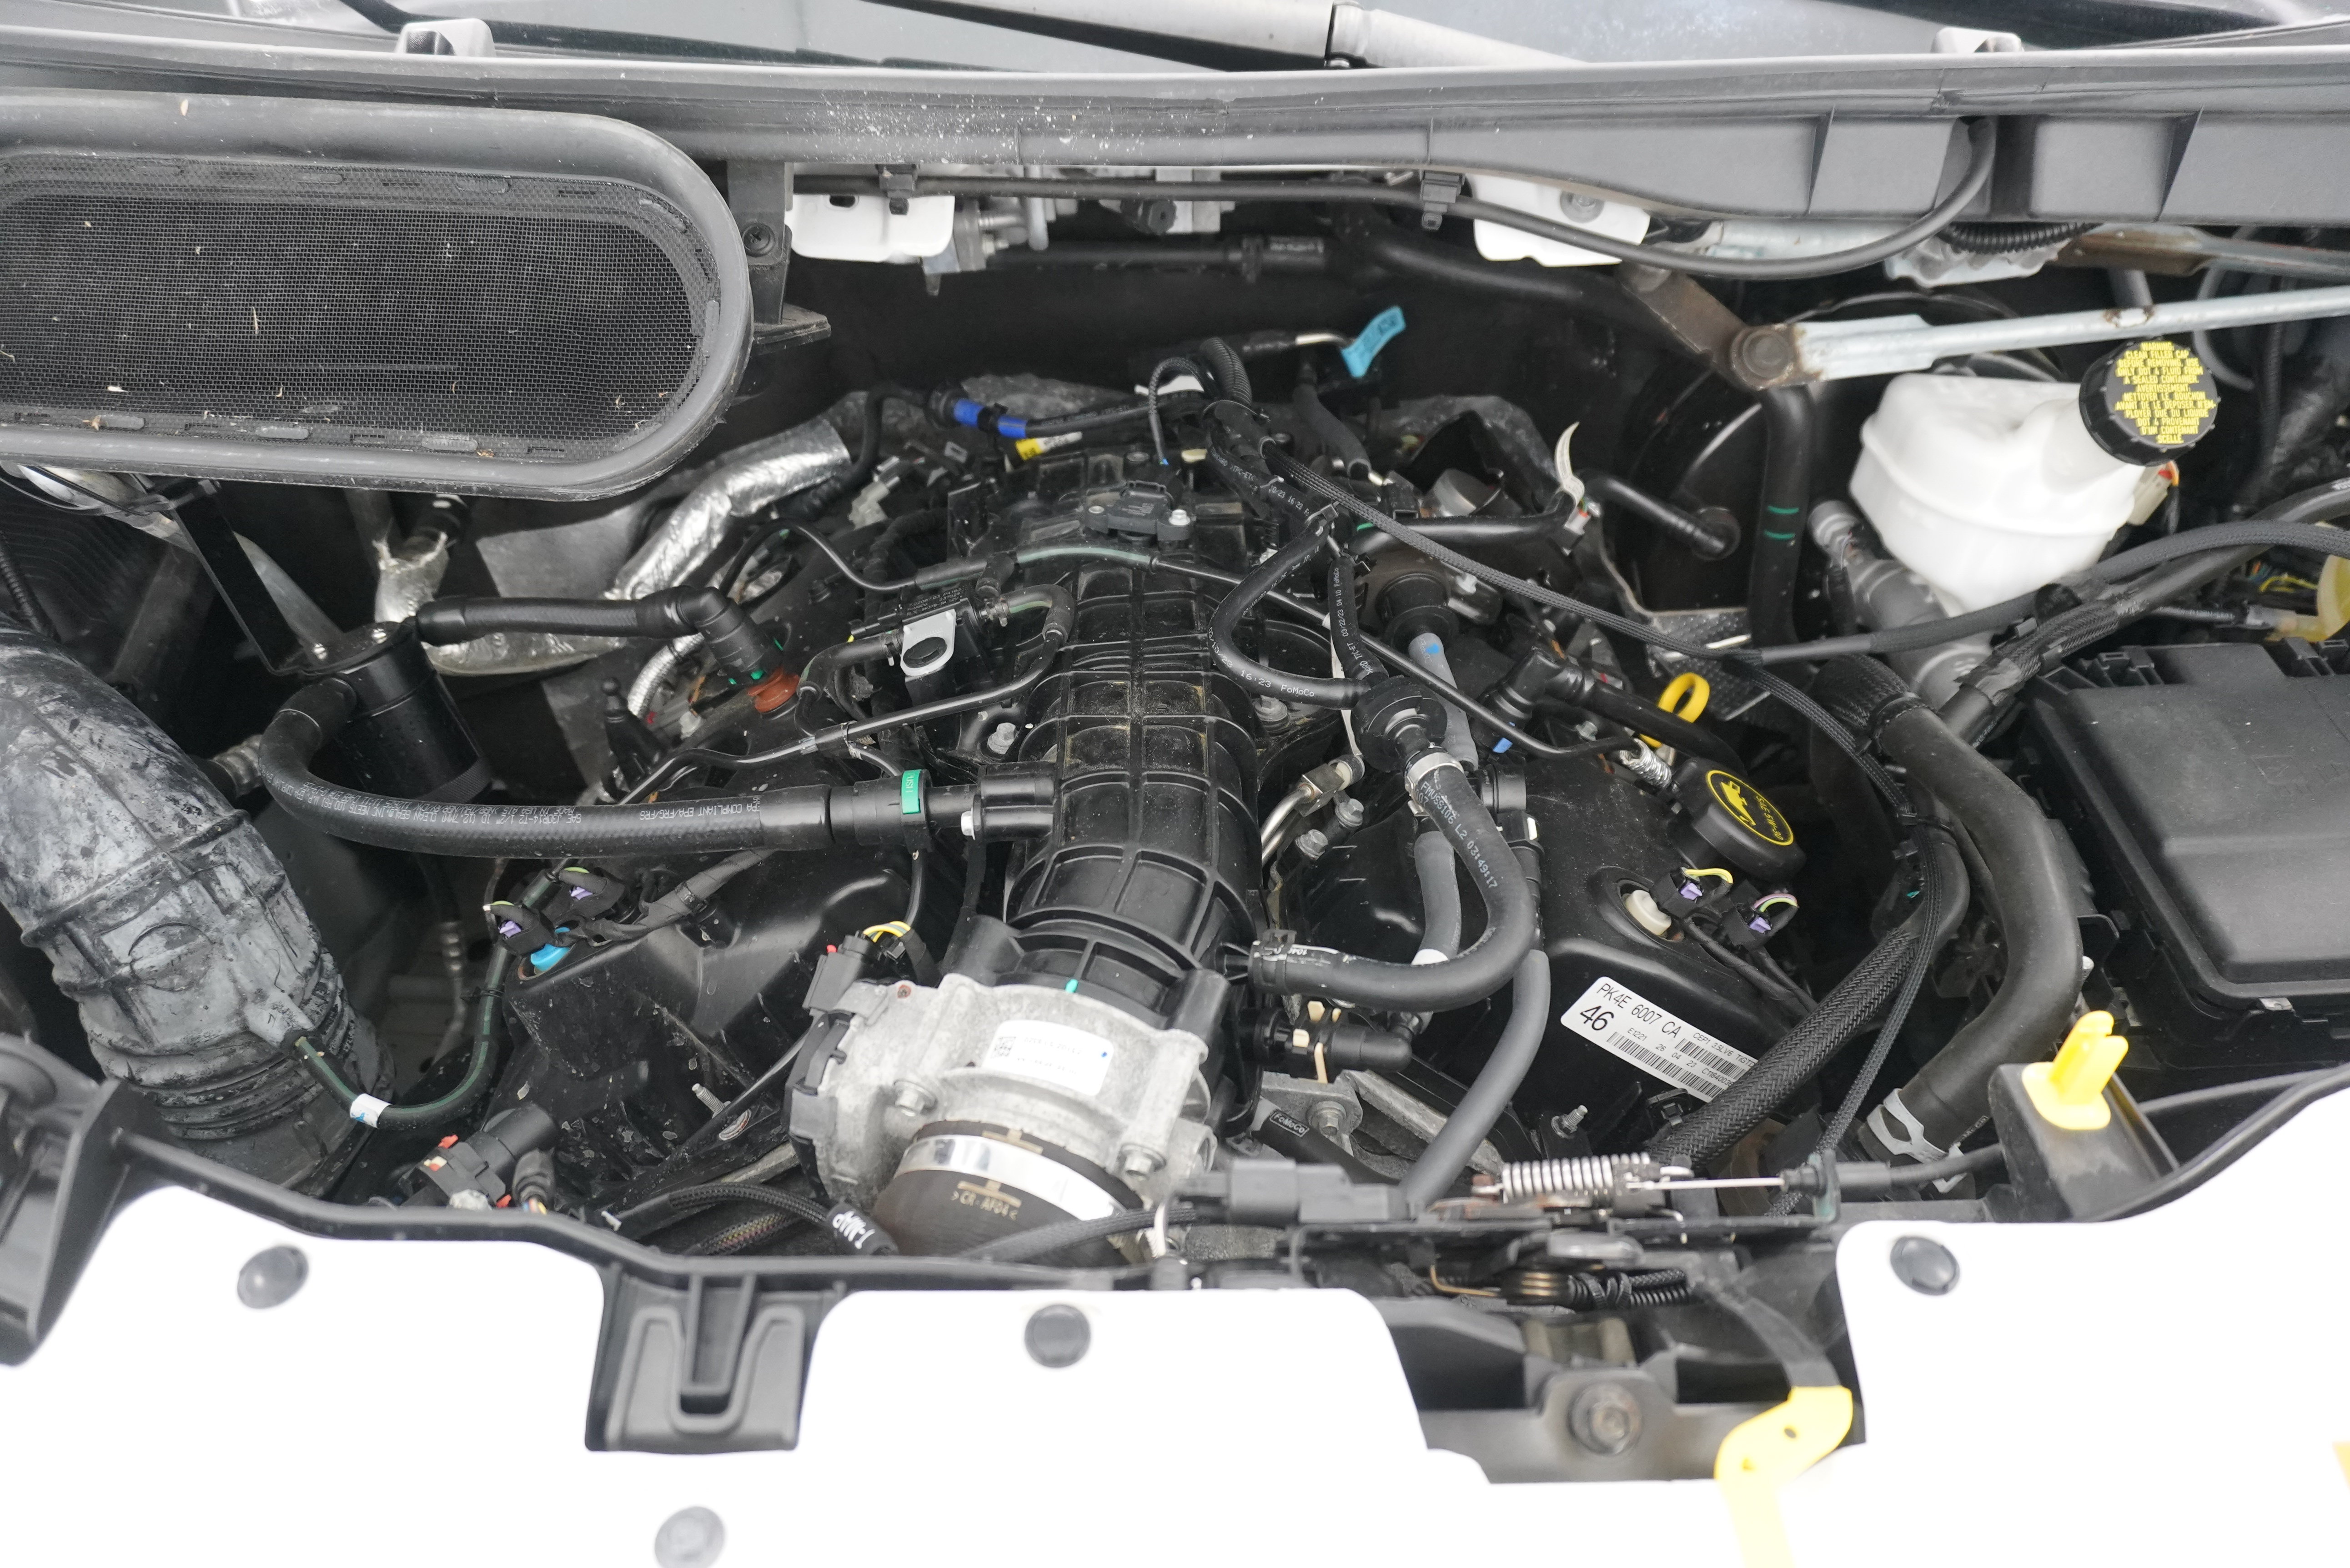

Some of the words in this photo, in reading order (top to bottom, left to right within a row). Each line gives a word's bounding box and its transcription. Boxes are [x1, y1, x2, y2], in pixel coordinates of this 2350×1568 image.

[2125, 351, 2148, 359] CLEAN
[2149, 350, 2173, 359] FILLER
[2175, 349, 2189, 358] CAP
[2117, 359, 2145, 368] BEFORE
[2185, 357, 2199, 367] USE
[2116, 367, 2135, 377] ONLY
[2137, 367, 2151, 376] DOT
[2153, 367, 2160, 375] 4
[2161, 367, 2182, 375] FLUID
[2183, 366, 2203, 375] FROM
[2124, 376, 2131, 384] A
[2132, 375, 2158, 384] SEALED
[2123, 392, 2158, 402] NETTOYER
[2160, 392, 2169, 401] LE
[2173, 391, 2205, 401] BOUCHON
[2115, 401, 2138, 411] AVANT
[2140, 401, 2150, 410] DE
[2152, 401, 2162, 409] LE
[2125, 409, 2152, 419] PLOYER
[2154, 409, 2168, 417] QUE
[2170, 409, 2181, 417] DU
[2183, 408, 2209, 417] LIQUIDE
[2136, 417, 2150, 427] DOT
[2153, 417, 2160, 426] 4
[2161, 417, 2199, 426] PROVENANT
[2160, 425, 2199, 434] CONTENANT
[1338, 609, 1349, 637] 03/22/23
[1240, 669, 1271, 689] 16:23
[1280, 684, 1315, 698] FoMoCo
[905, 773, 914, 793] PUSH
[347, 804, 370, 816] MEETS
[522, 806, 537, 815] USA
[539, 806, 549, 814] IN
[698, 803, 742, 818] COMPLIANT
[413, 811, 437, 823] CLEAN
[481, 814, 490, 824] ID
[1455, 823, 1468, 841] L2
[1466, 840, 1498, 889] 03:49:17
[1596, 983, 1632, 1009] PK4E
[1631, 1004, 1662, 1025] 6007
[1662, 1021, 1682, 1038] CA
[1580, 1005, 1615, 1031] 46
[1693, 1032, 1711, 1044] CEP1
[1627, 1028, 1647, 1040] E1221
[1672, 1052, 1681, 1060] 04
[1274, 1112, 1306, 1135] FoMoCo
